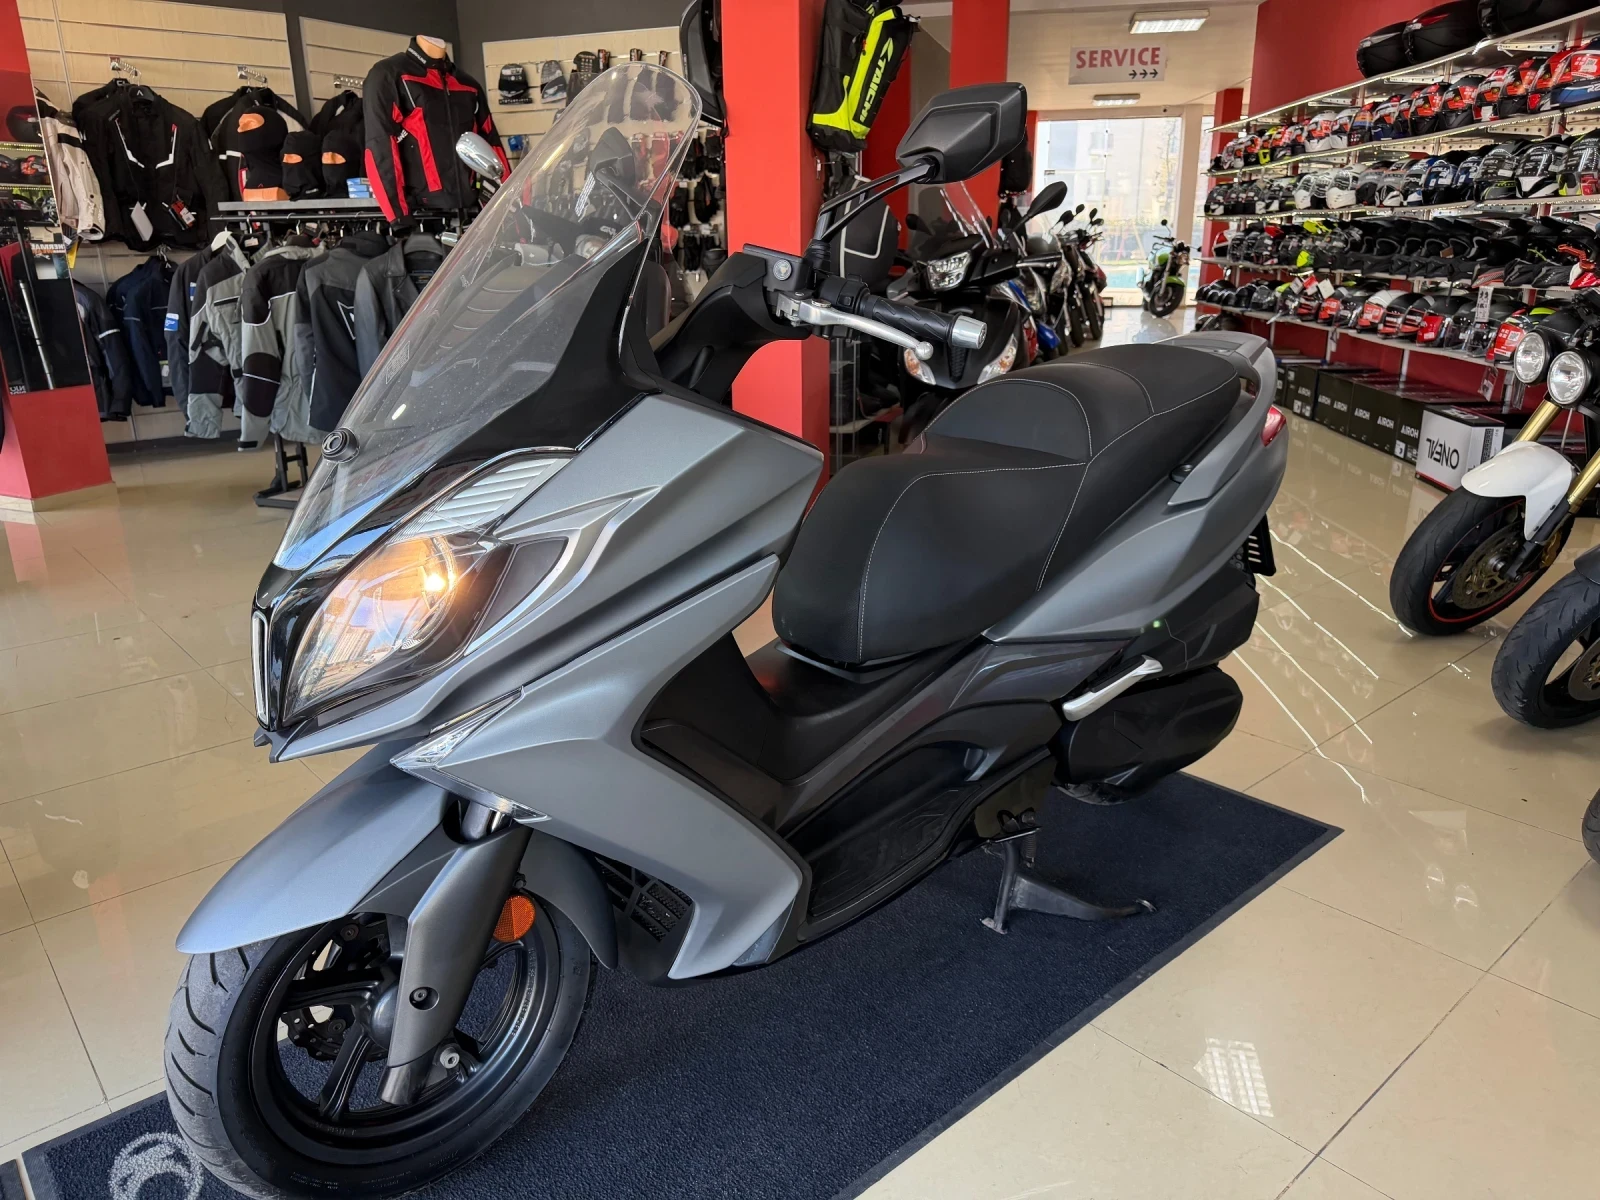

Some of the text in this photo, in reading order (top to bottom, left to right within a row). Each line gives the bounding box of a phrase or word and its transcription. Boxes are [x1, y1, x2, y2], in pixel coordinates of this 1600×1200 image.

[1075, 47, 1161, 69] SERVICE
[1318, 394, 1331, 406] AIROH
[1333, 400, 1347, 412] AIROH
[1354, 407, 1370, 420] AIROH
[1377, 415, 1394, 429] AIROH
[1400, 424, 1419, 439] AIROH
